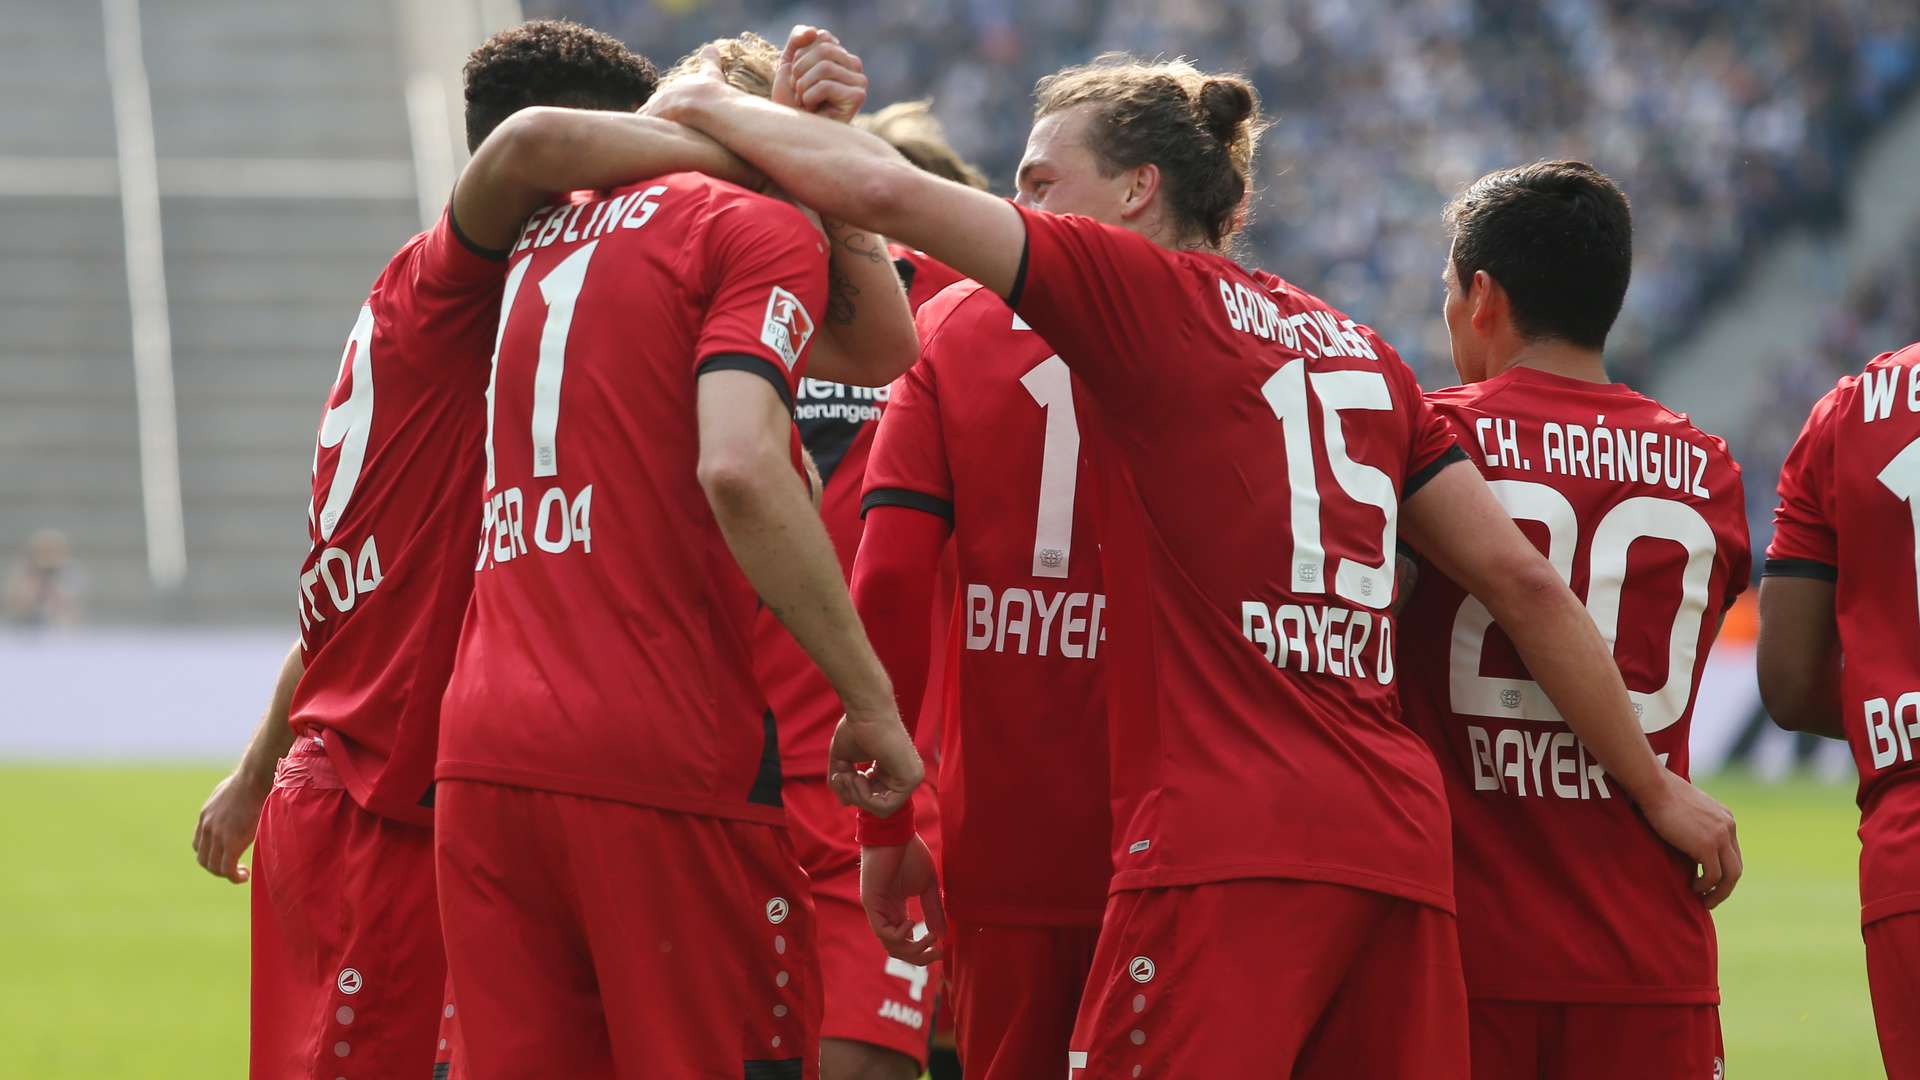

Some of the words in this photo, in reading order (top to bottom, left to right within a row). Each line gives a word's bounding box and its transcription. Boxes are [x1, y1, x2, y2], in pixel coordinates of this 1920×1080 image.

[508, 185, 669, 258] EßLING
[309, 304, 375, 552] 9
[1019, 353, 1081, 579] 1
[1475, 417, 1531, 471] CH.
[1542, 414, 1711, 499] ARÁNGUIZ
[534, 484, 593, 554] 04
[1261, 358, 1398, 609] 15
[1241, 600, 1373, 679] BAYER
[1376, 616, 1394, 685] 0
[1449, 479, 1717, 734] 20
[877, 998, 924, 1030] JAKO
